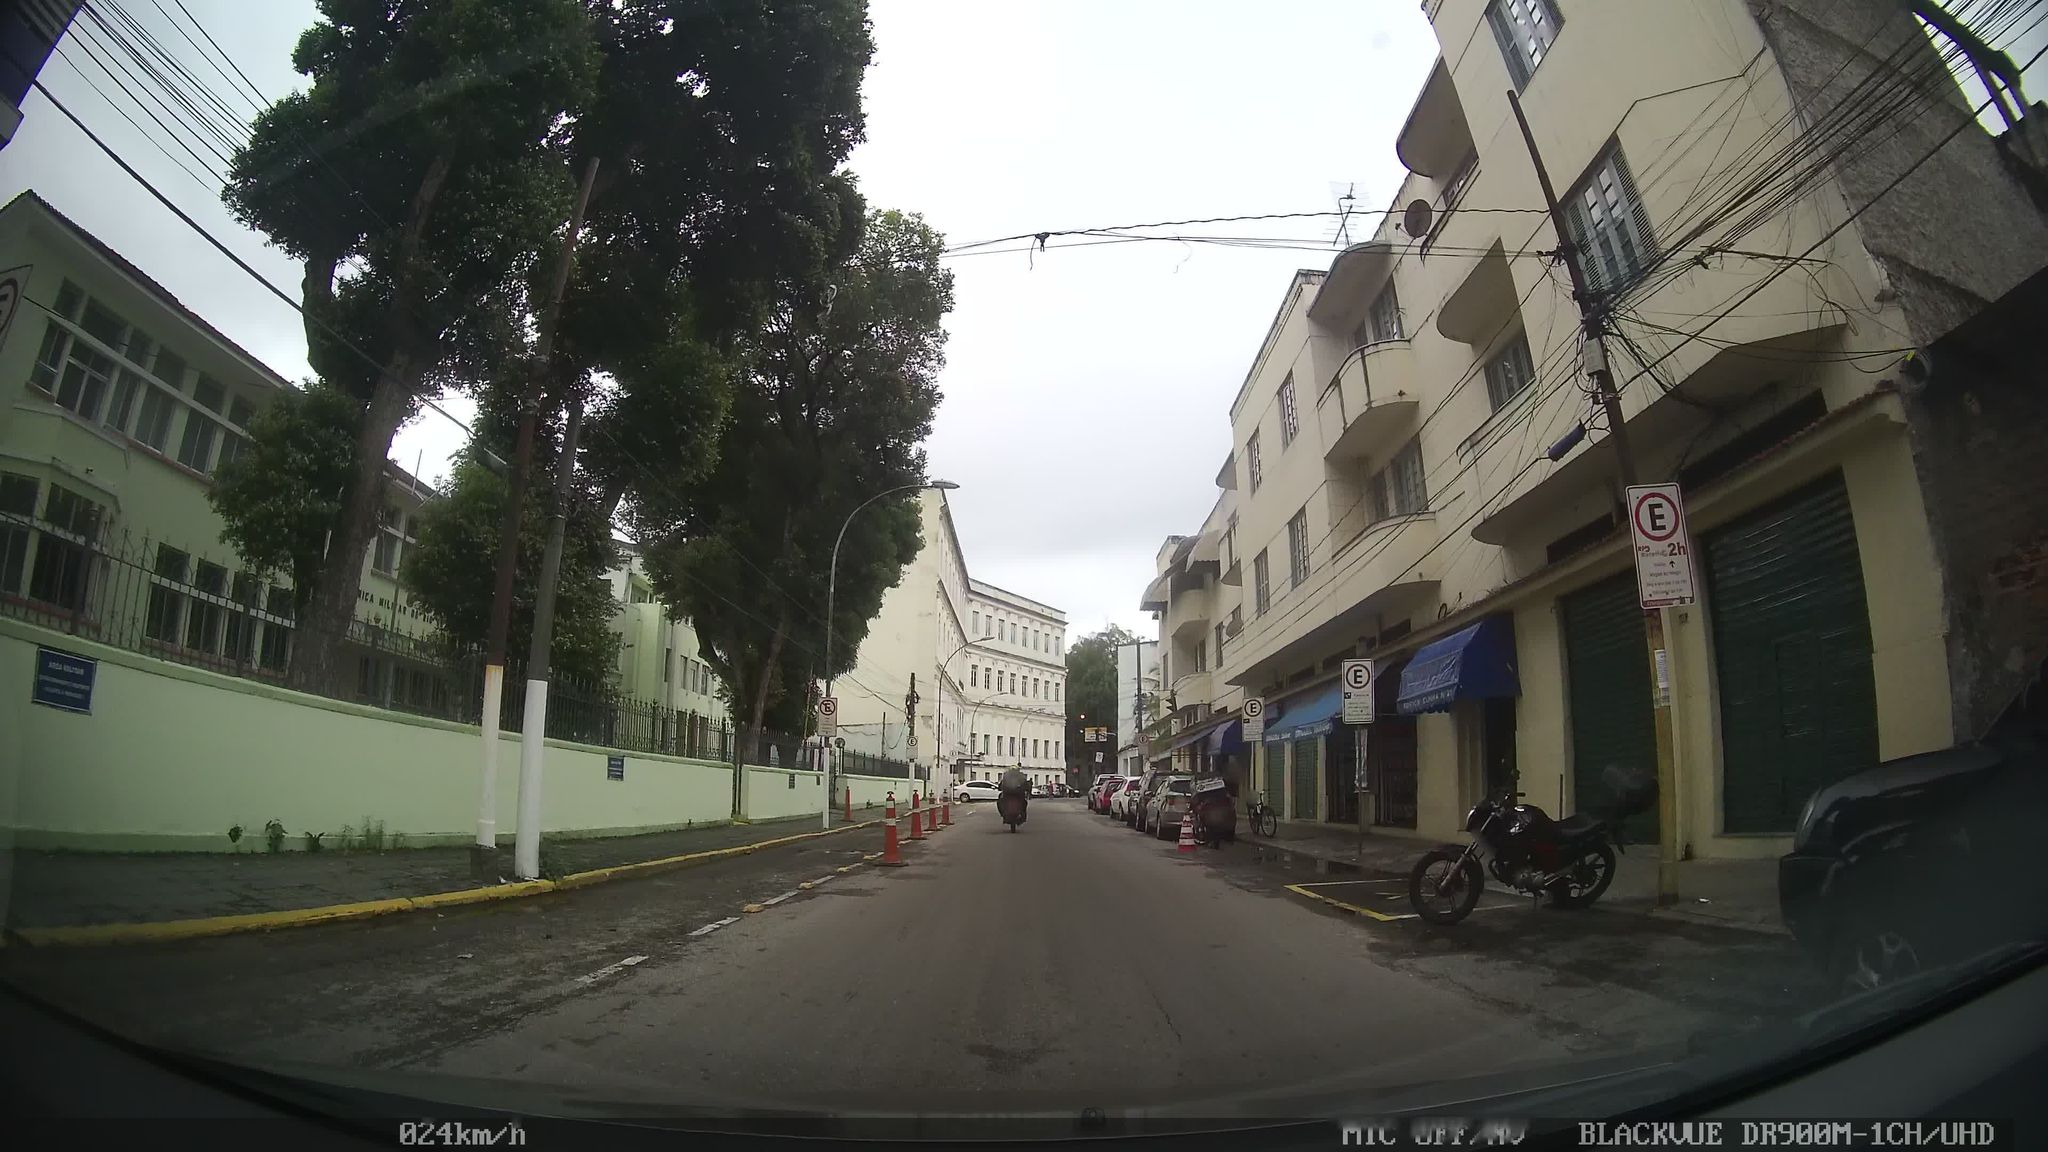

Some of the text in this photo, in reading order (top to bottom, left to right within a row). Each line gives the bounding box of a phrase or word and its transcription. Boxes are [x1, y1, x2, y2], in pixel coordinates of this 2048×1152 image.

[1648, 503, 1666, 531] E
[1667, 542, 1687, 556] 2h
[379, 597, 407, 615] MILIAR
[1353, 669, 1363, 684] E
[1250, 702, 1257, 714] E
